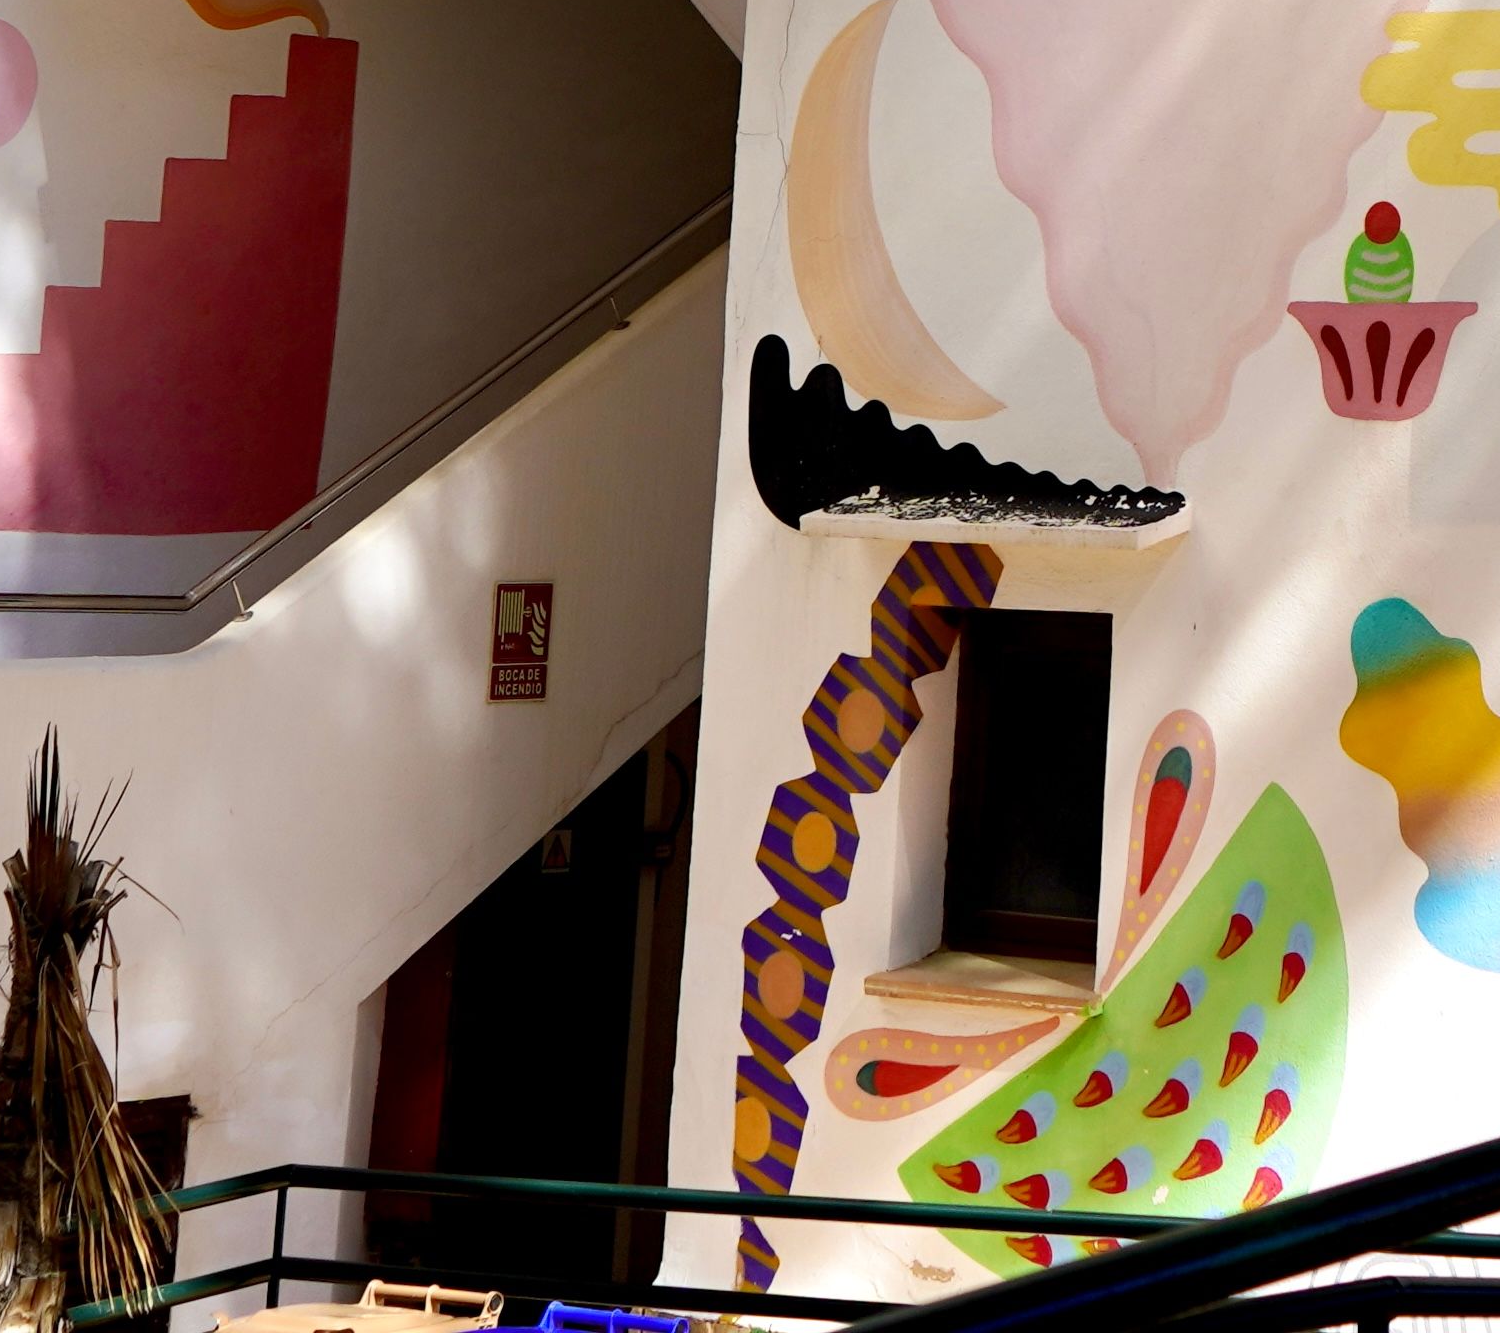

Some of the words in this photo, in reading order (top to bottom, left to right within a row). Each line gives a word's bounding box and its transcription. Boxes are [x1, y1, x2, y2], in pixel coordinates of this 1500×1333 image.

[498, 669, 525, 681] BOCA
[527, 669, 540, 680] DE
[494, 683, 542, 695] INCENDIO
